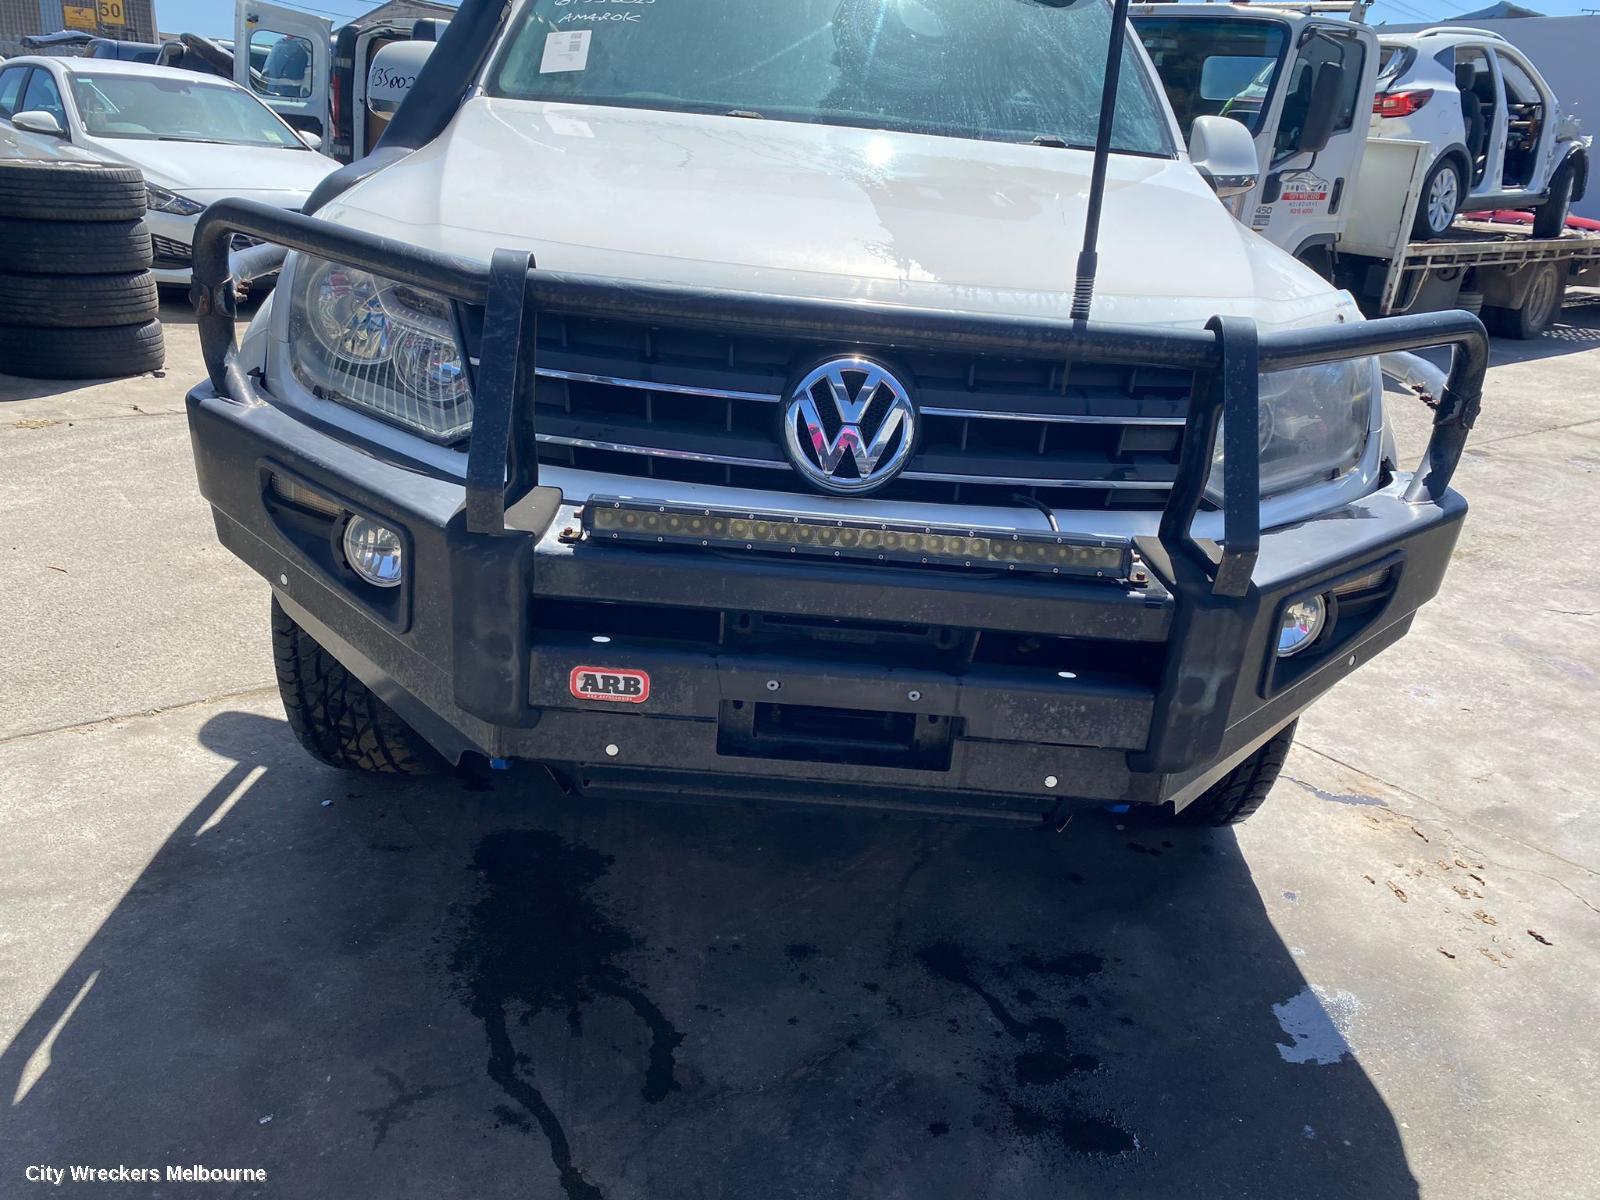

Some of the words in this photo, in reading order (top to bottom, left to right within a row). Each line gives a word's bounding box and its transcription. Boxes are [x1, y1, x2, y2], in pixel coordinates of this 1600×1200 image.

[101, 3, 120, 17] 50
[558, 12, 640, 23] AMAROK
[1256, 206, 1272, 214] 450
[580, 674, 641, 695] ARB
